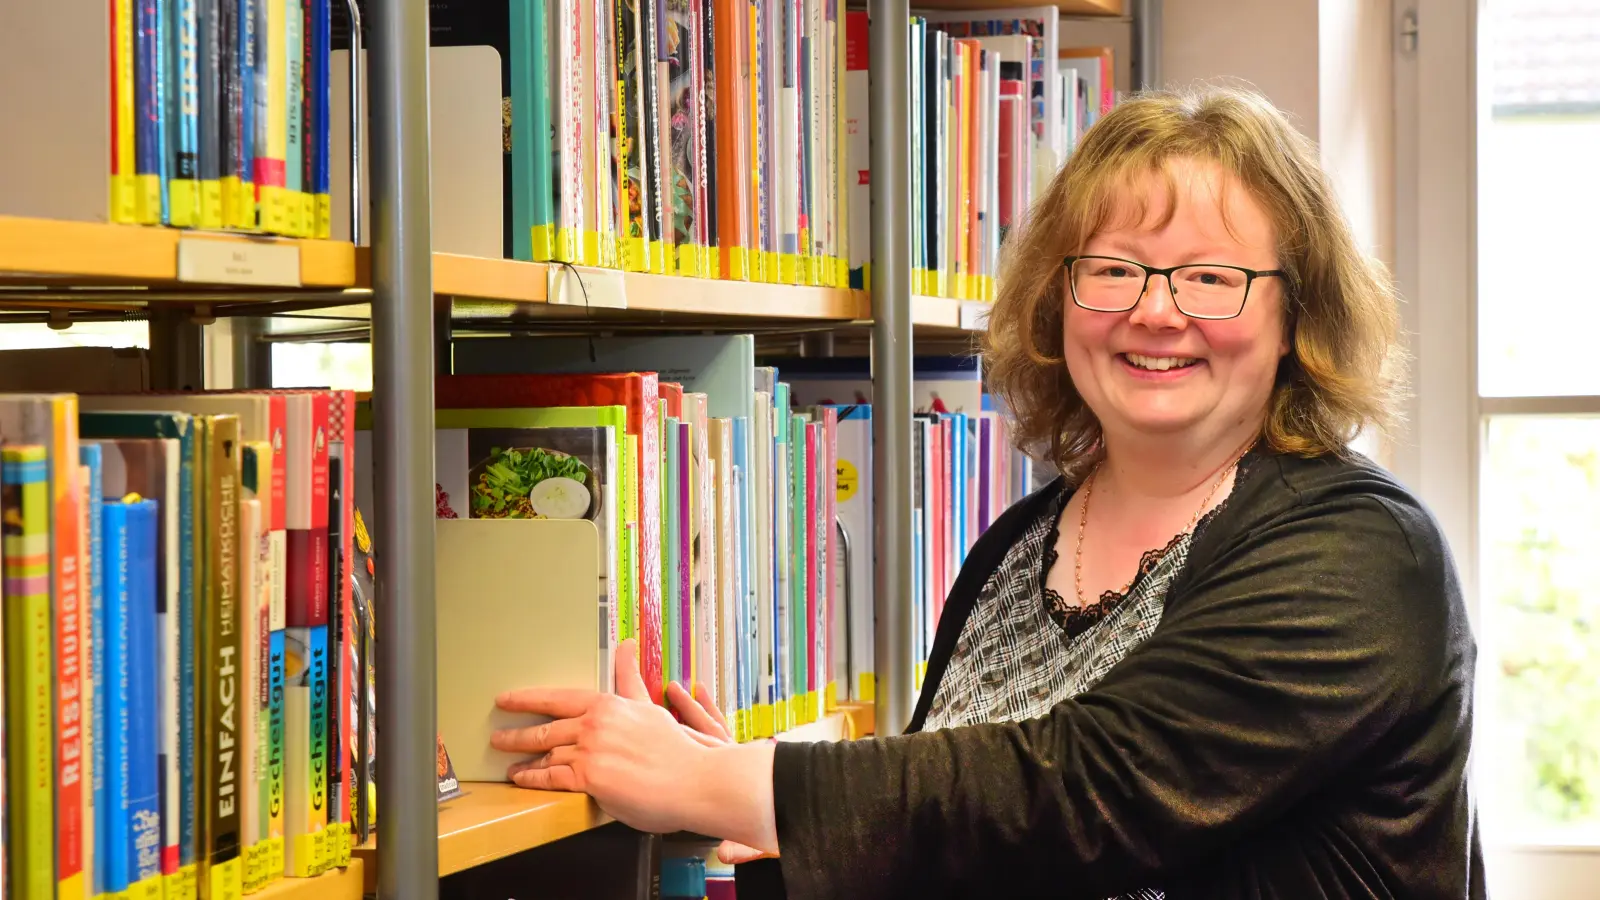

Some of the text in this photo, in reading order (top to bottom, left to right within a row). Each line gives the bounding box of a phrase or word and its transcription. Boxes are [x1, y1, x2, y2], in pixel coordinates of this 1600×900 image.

[619, 85, 627, 148] backen
[60, 554, 81, 787] REISEHUNGER
[218, 645, 236, 819] EINFACH
[268, 650, 284, 819] Gscheitgut
[311, 645, 326, 811] Gscheitgut
